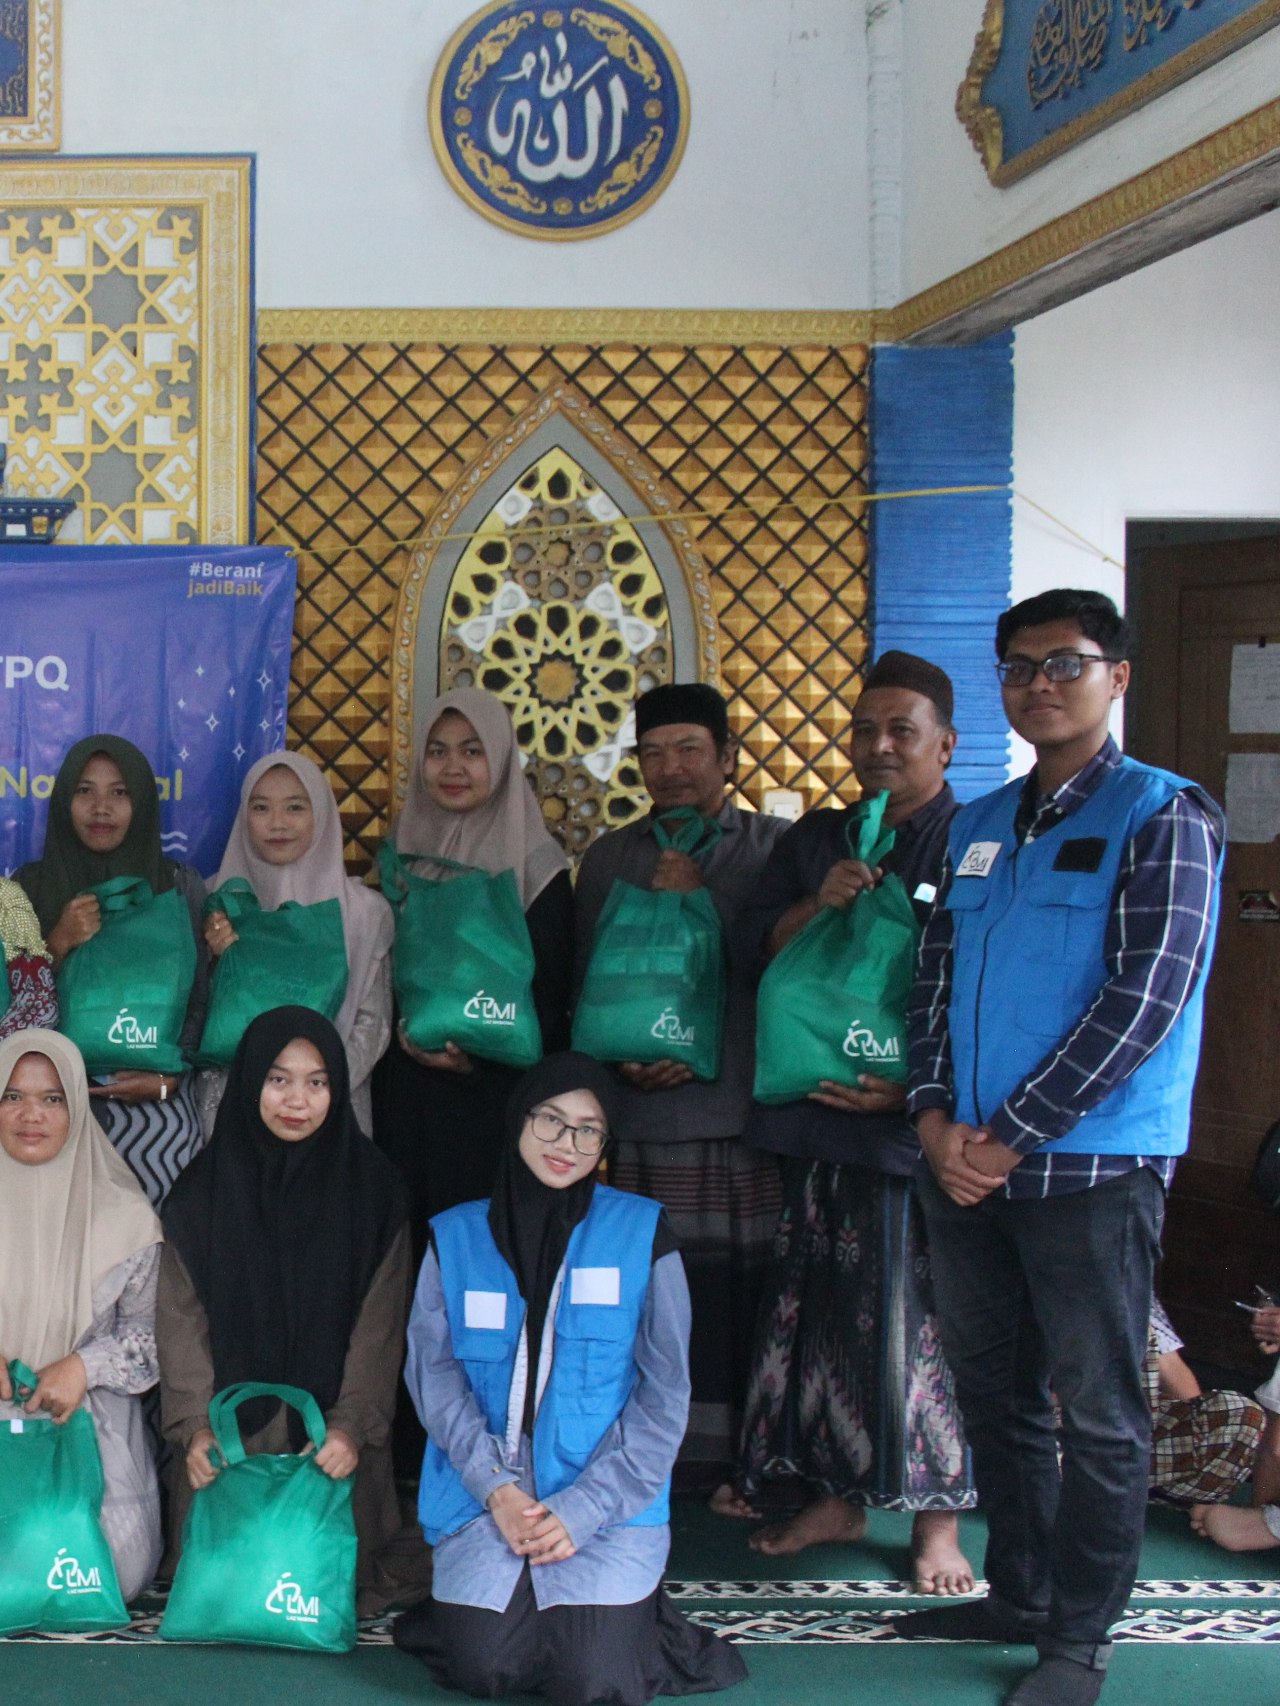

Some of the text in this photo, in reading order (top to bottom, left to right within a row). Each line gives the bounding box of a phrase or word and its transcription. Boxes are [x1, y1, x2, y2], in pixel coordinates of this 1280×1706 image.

[189, 561, 265, 578] #Berani
[187, 579, 265, 599] jadiBaik
[483, 1001, 516, 1020] LMI
[126, 1026, 157, 1043] LMI
[861, 1036, 900, 1056] LMI
[66, 1567, 102, 1588] LMI
[286, 1594, 319, 1616] LMI
